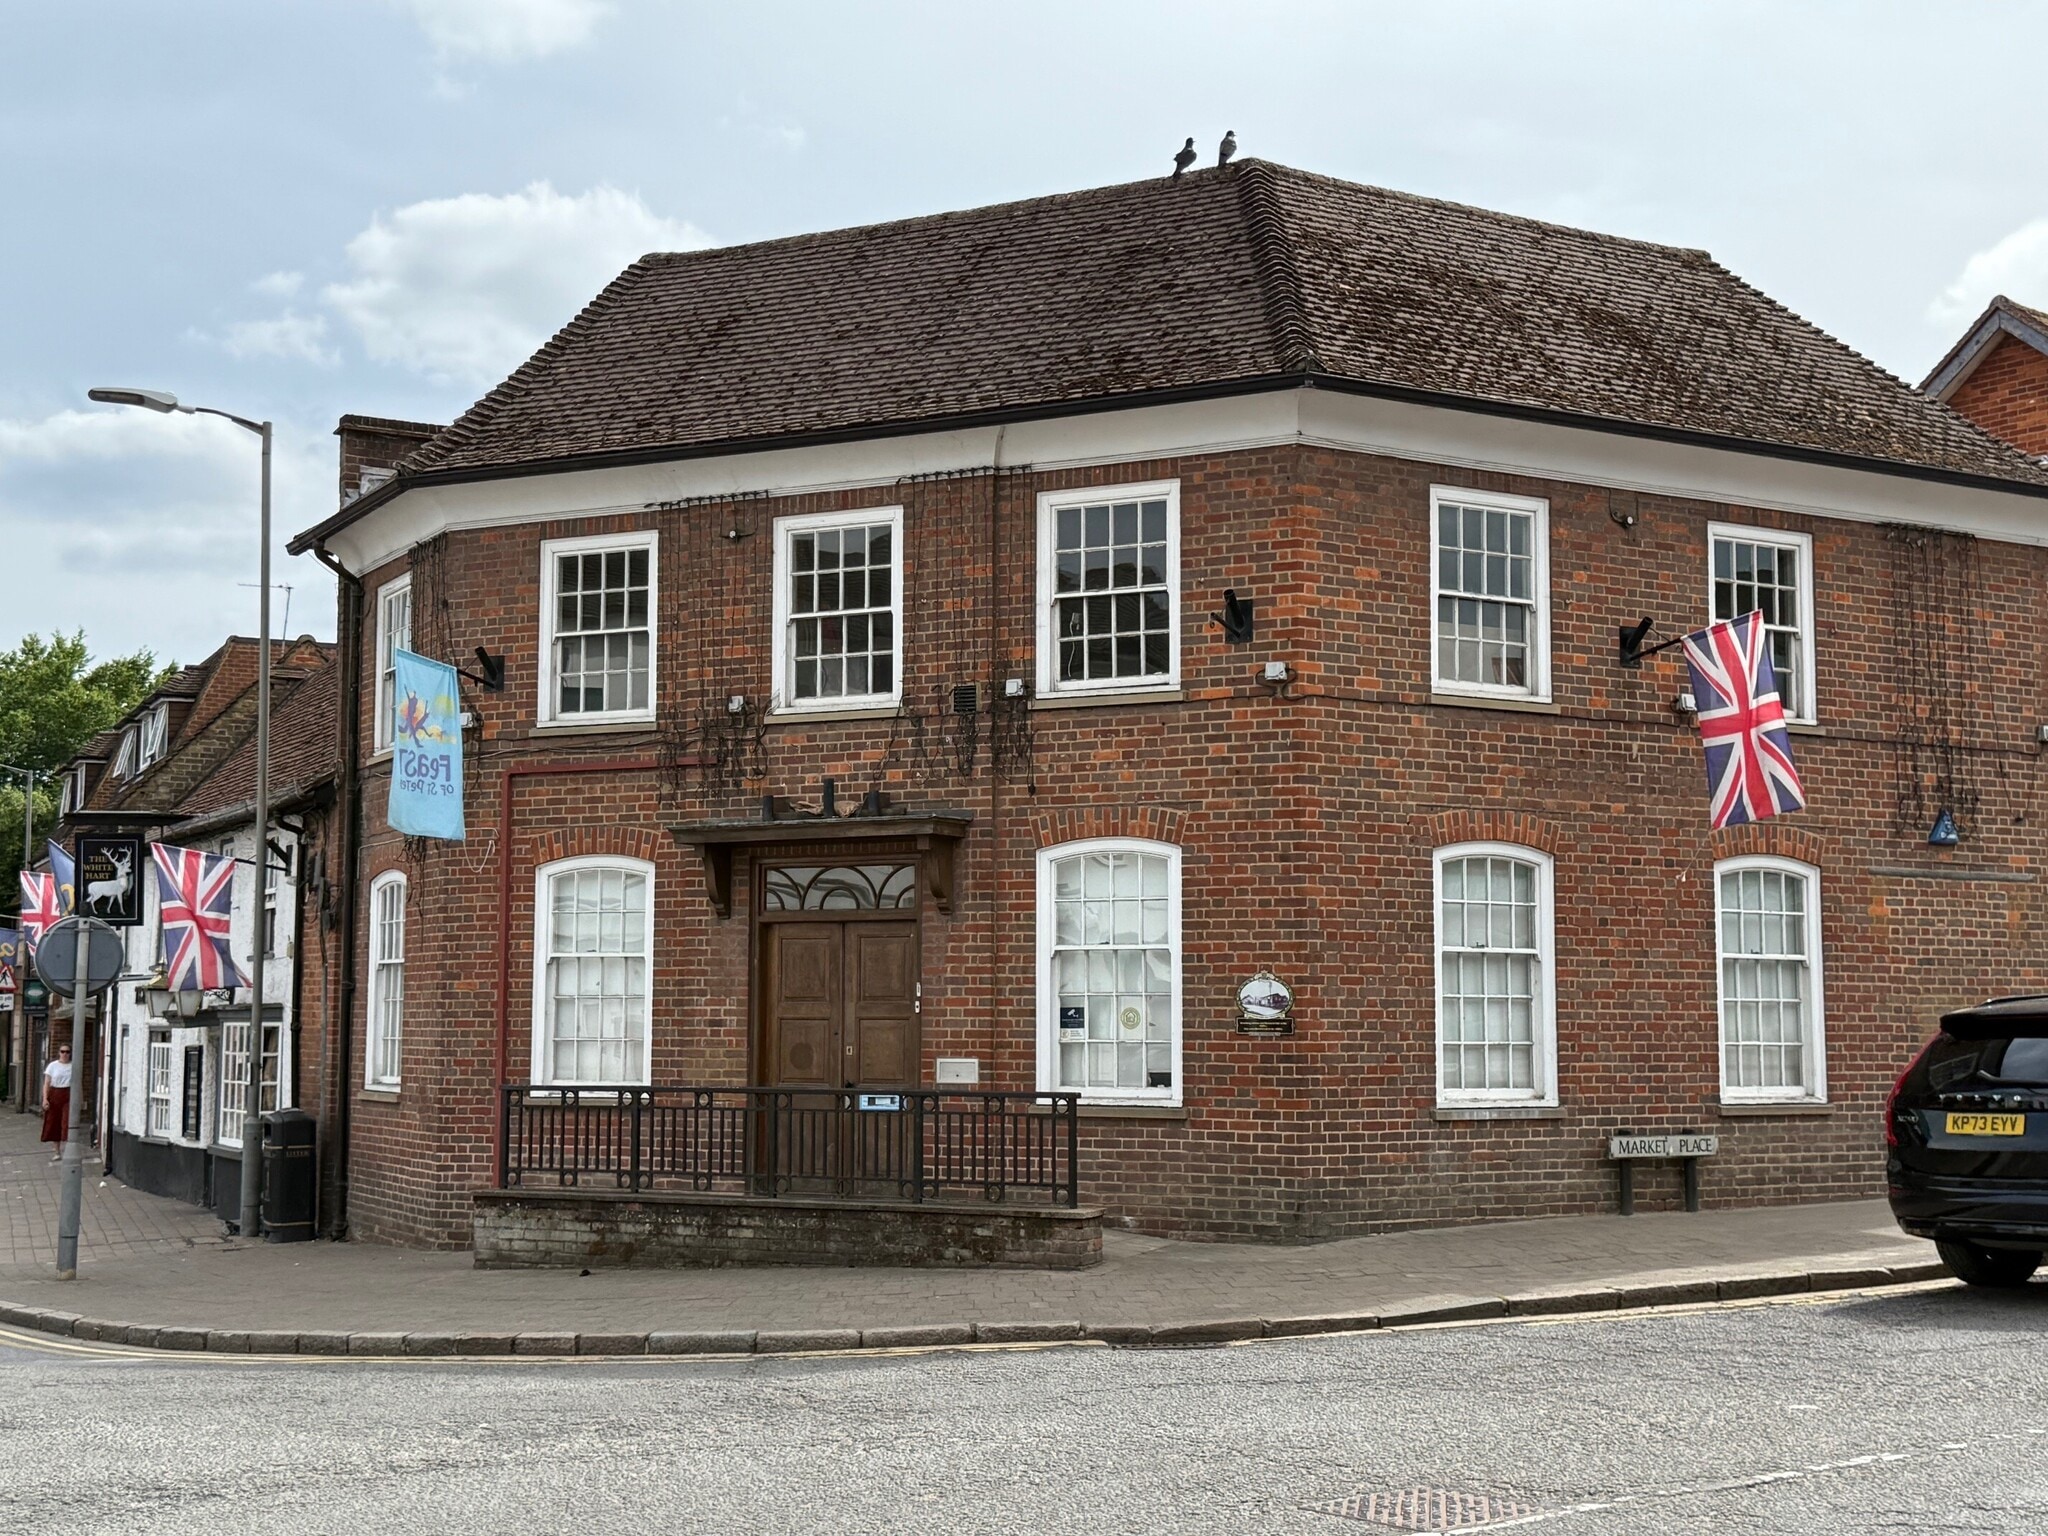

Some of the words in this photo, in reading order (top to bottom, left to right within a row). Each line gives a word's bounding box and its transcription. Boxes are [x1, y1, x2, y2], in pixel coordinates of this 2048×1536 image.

[88, 855, 108, 863] THE
[85, 872, 110, 880] HART
[1951, 1115, 1988, 1131] KP73
[1990, 1116, 2018, 1132] EYV
[1618, 1139, 1667, 1154] MARKET
[1679, 1138, 1712, 1153] PLACE
